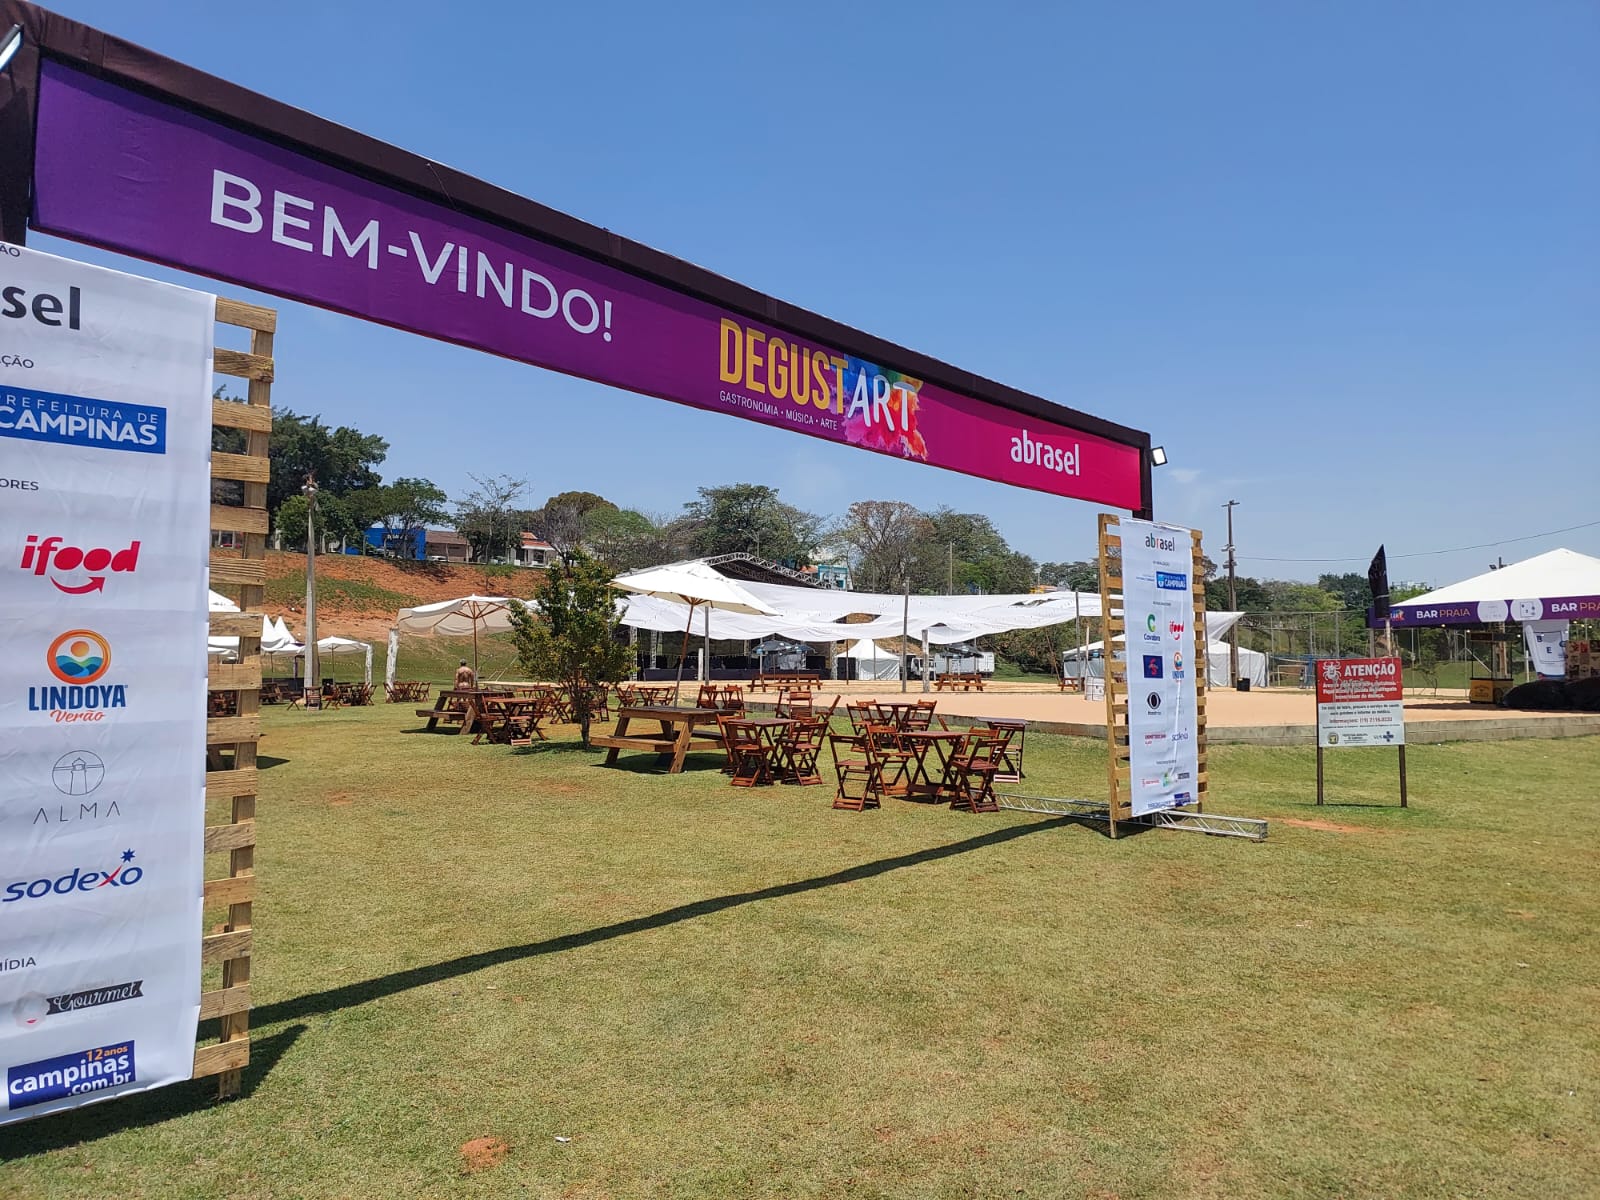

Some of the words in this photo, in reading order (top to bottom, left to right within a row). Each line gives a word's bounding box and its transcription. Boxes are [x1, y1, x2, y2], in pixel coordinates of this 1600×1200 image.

[210, 169, 612, 342] BEM-VINDO!
[0, 354, 34, 368] ÇÃO
[0, 394, 122, 420] REFEITURA
[137, 412, 159, 424] DE
[719, 390, 779, 417] GASTRONOMIA
[785, 408, 814, 425] MÚSICA
[820, 418, 838, 431] ARTE
[1010, 429, 1080, 476] abrasel
[20, 535, 141, 576] ifood
[1145, 532, 1175, 552] abrasel
[1416, 610, 1438, 619] BAR
[1439, 607, 1471, 617] PRAIA
[1551, 602, 1578, 613] BAR
[1344, 661, 1396, 679] ATENÇÃO
[28, 684, 126, 711] LINDOYA
[50, 708, 105, 723] Verão
[33, 800, 121, 825] ALMA
[2, 864, 143, 902] sodexo
[53, 983, 138, 1012] Gourmet
[86, 1048, 104, 1062] 12
[104, 1046, 128, 1056] anos
[9, 1054, 130, 1095] campinas
